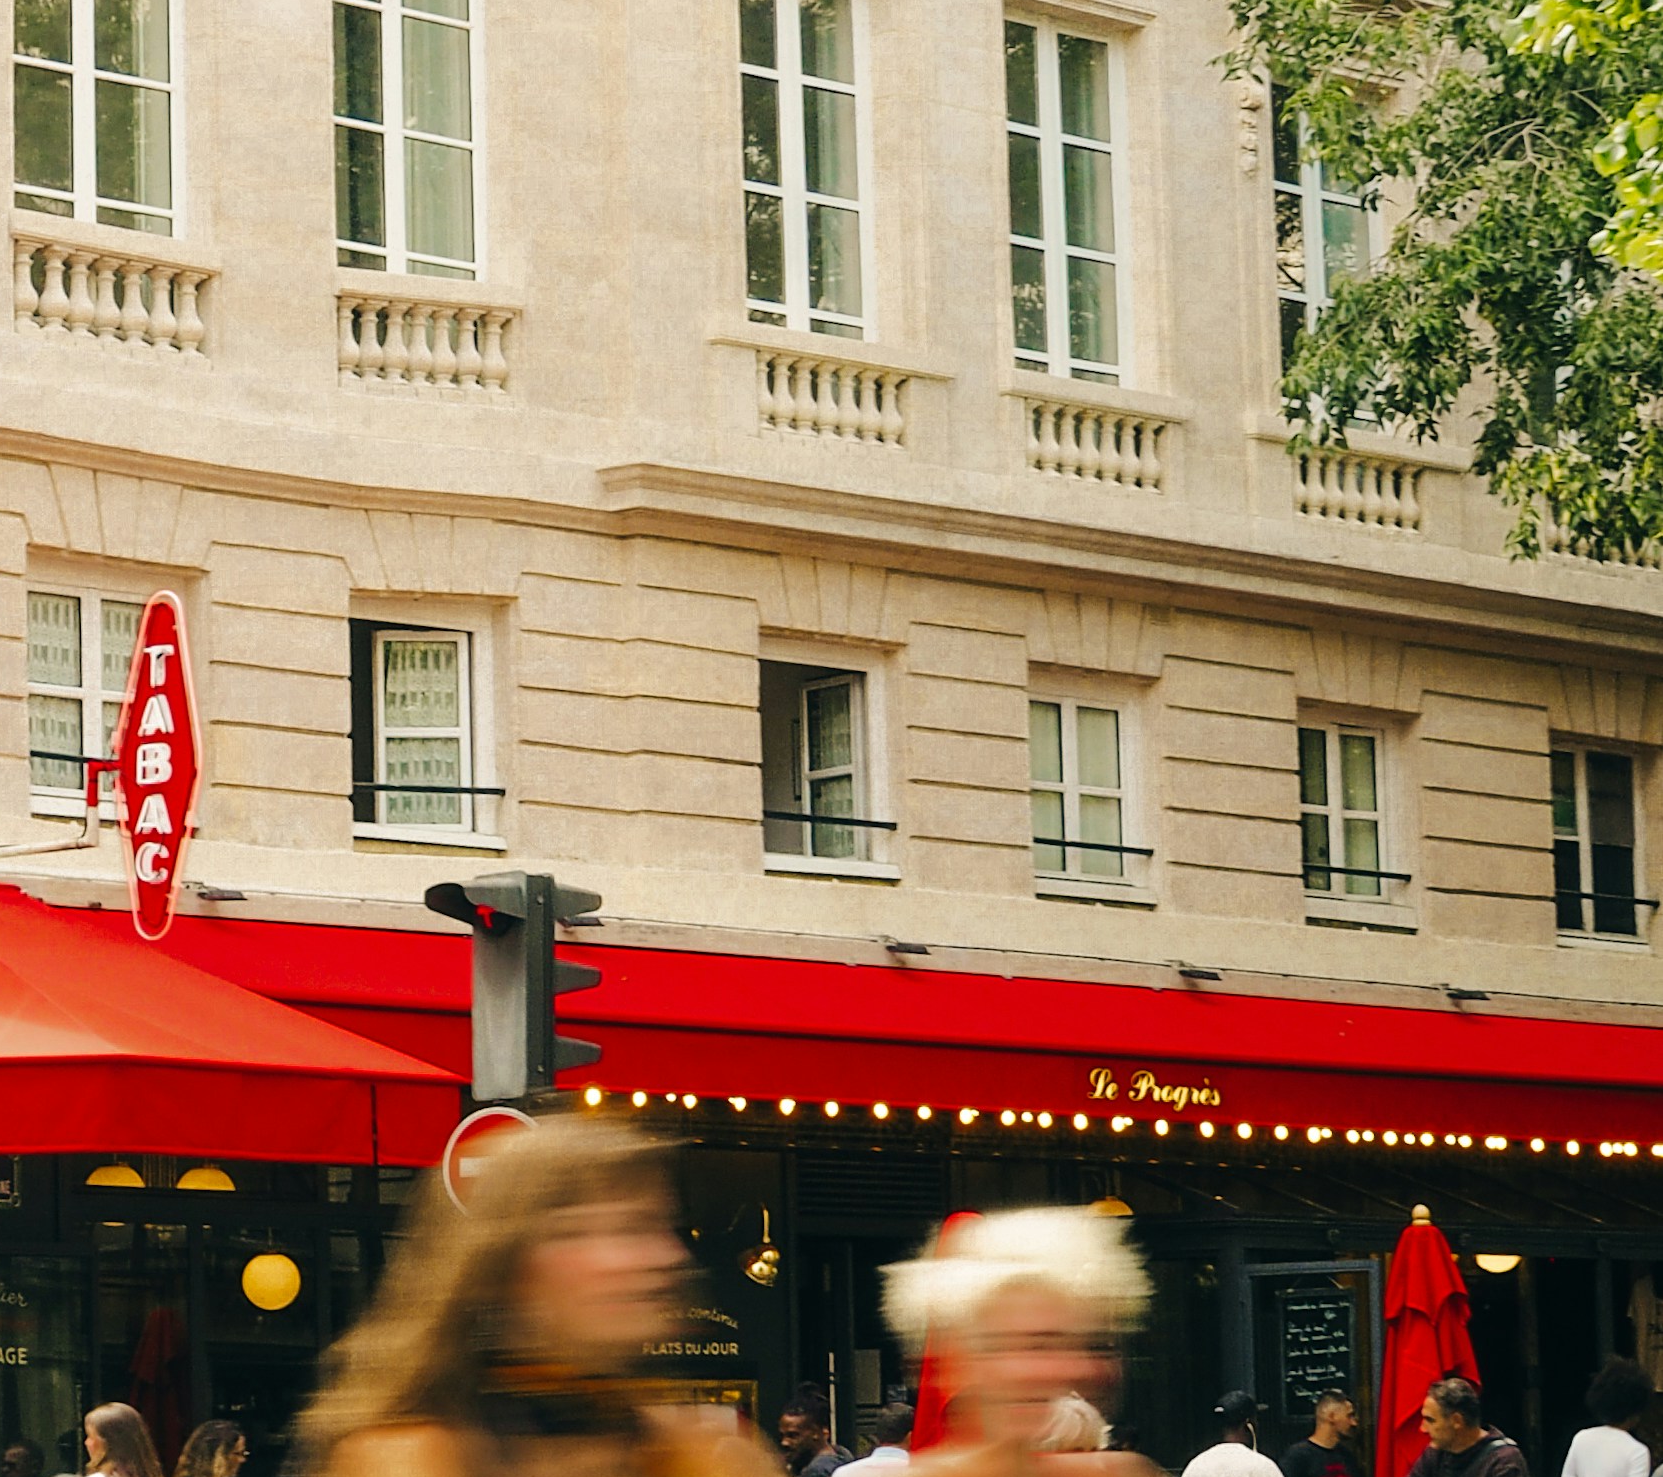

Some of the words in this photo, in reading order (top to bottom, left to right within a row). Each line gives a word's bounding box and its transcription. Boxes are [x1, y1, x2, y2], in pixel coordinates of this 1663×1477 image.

[135, 644, 175, 884] TABAC
[1087, 1067, 1119, 1101] Le
[1128, 1069, 1221, 1112] Progrès
[641, 1342, 683, 1355] PLATS
[702, 1342, 739, 1356] JOUR
